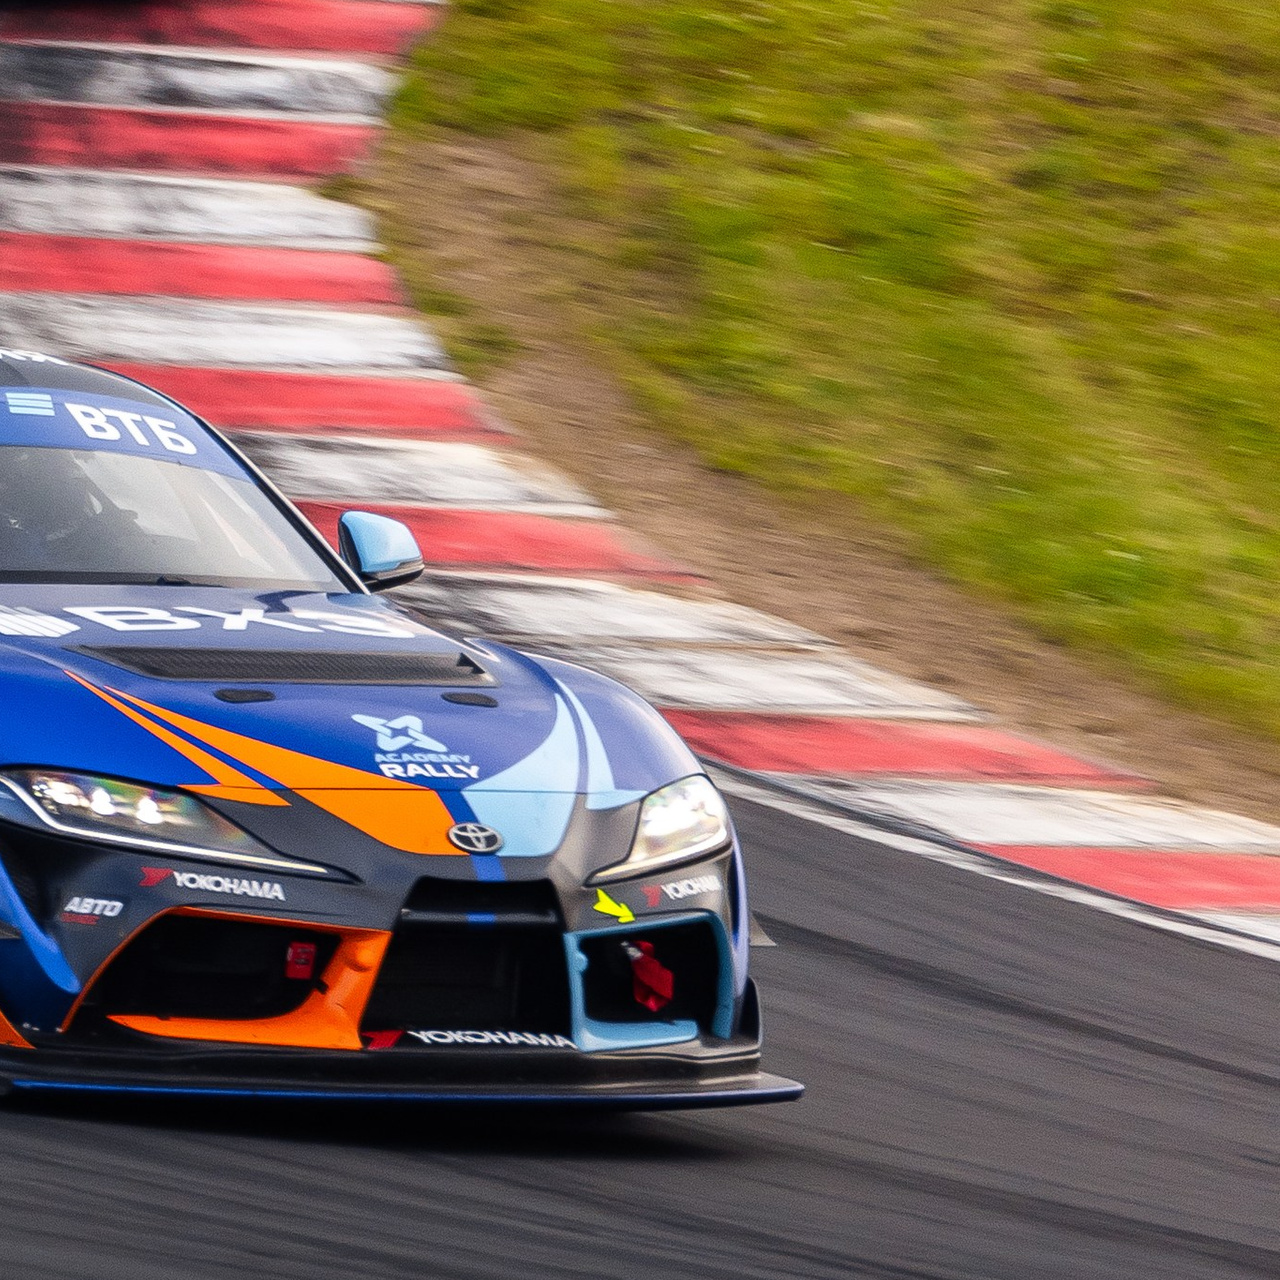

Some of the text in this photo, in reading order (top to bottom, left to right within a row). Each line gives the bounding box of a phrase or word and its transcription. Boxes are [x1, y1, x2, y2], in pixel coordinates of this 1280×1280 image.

[64, 402, 198, 456] ВТБ
[374, 752, 471, 763] ACADEMY
[379, 763, 481, 779] RALLY
[173, 870, 288, 902] YOKOHAMA
[406, 1029, 580, 1050] YOKOHAMA
